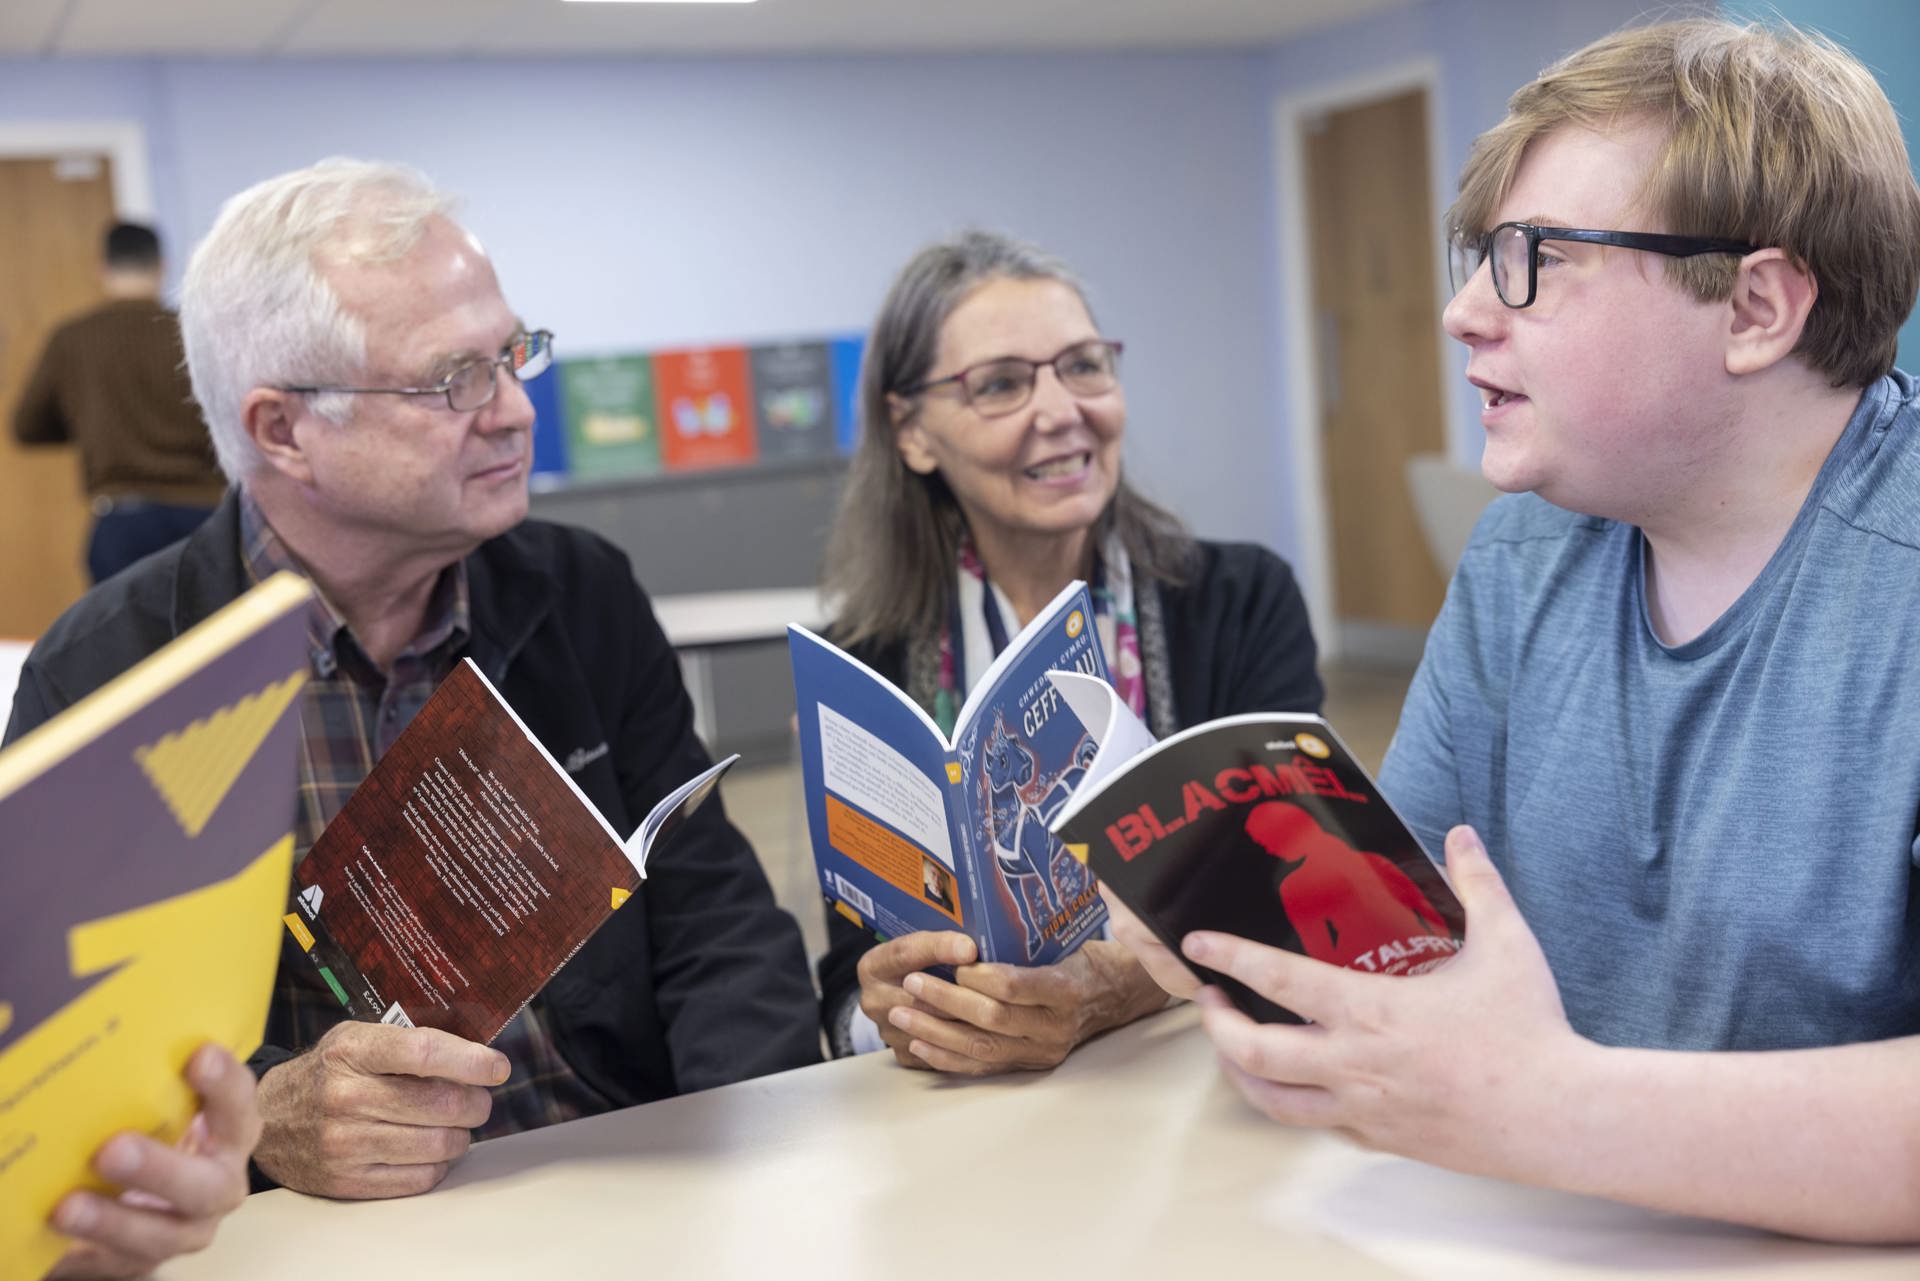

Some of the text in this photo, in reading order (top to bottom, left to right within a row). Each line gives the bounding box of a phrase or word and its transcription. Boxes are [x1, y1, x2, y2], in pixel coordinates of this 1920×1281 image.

[1018, 662, 1059, 708] CHWEDLU
[1023, 647, 1097, 738] CEFFAU
[1104, 755, 1368, 862] BLACMÊL
[296, 895, 315, 920] atebol
[362, 990, 381, 1014] £4.99
